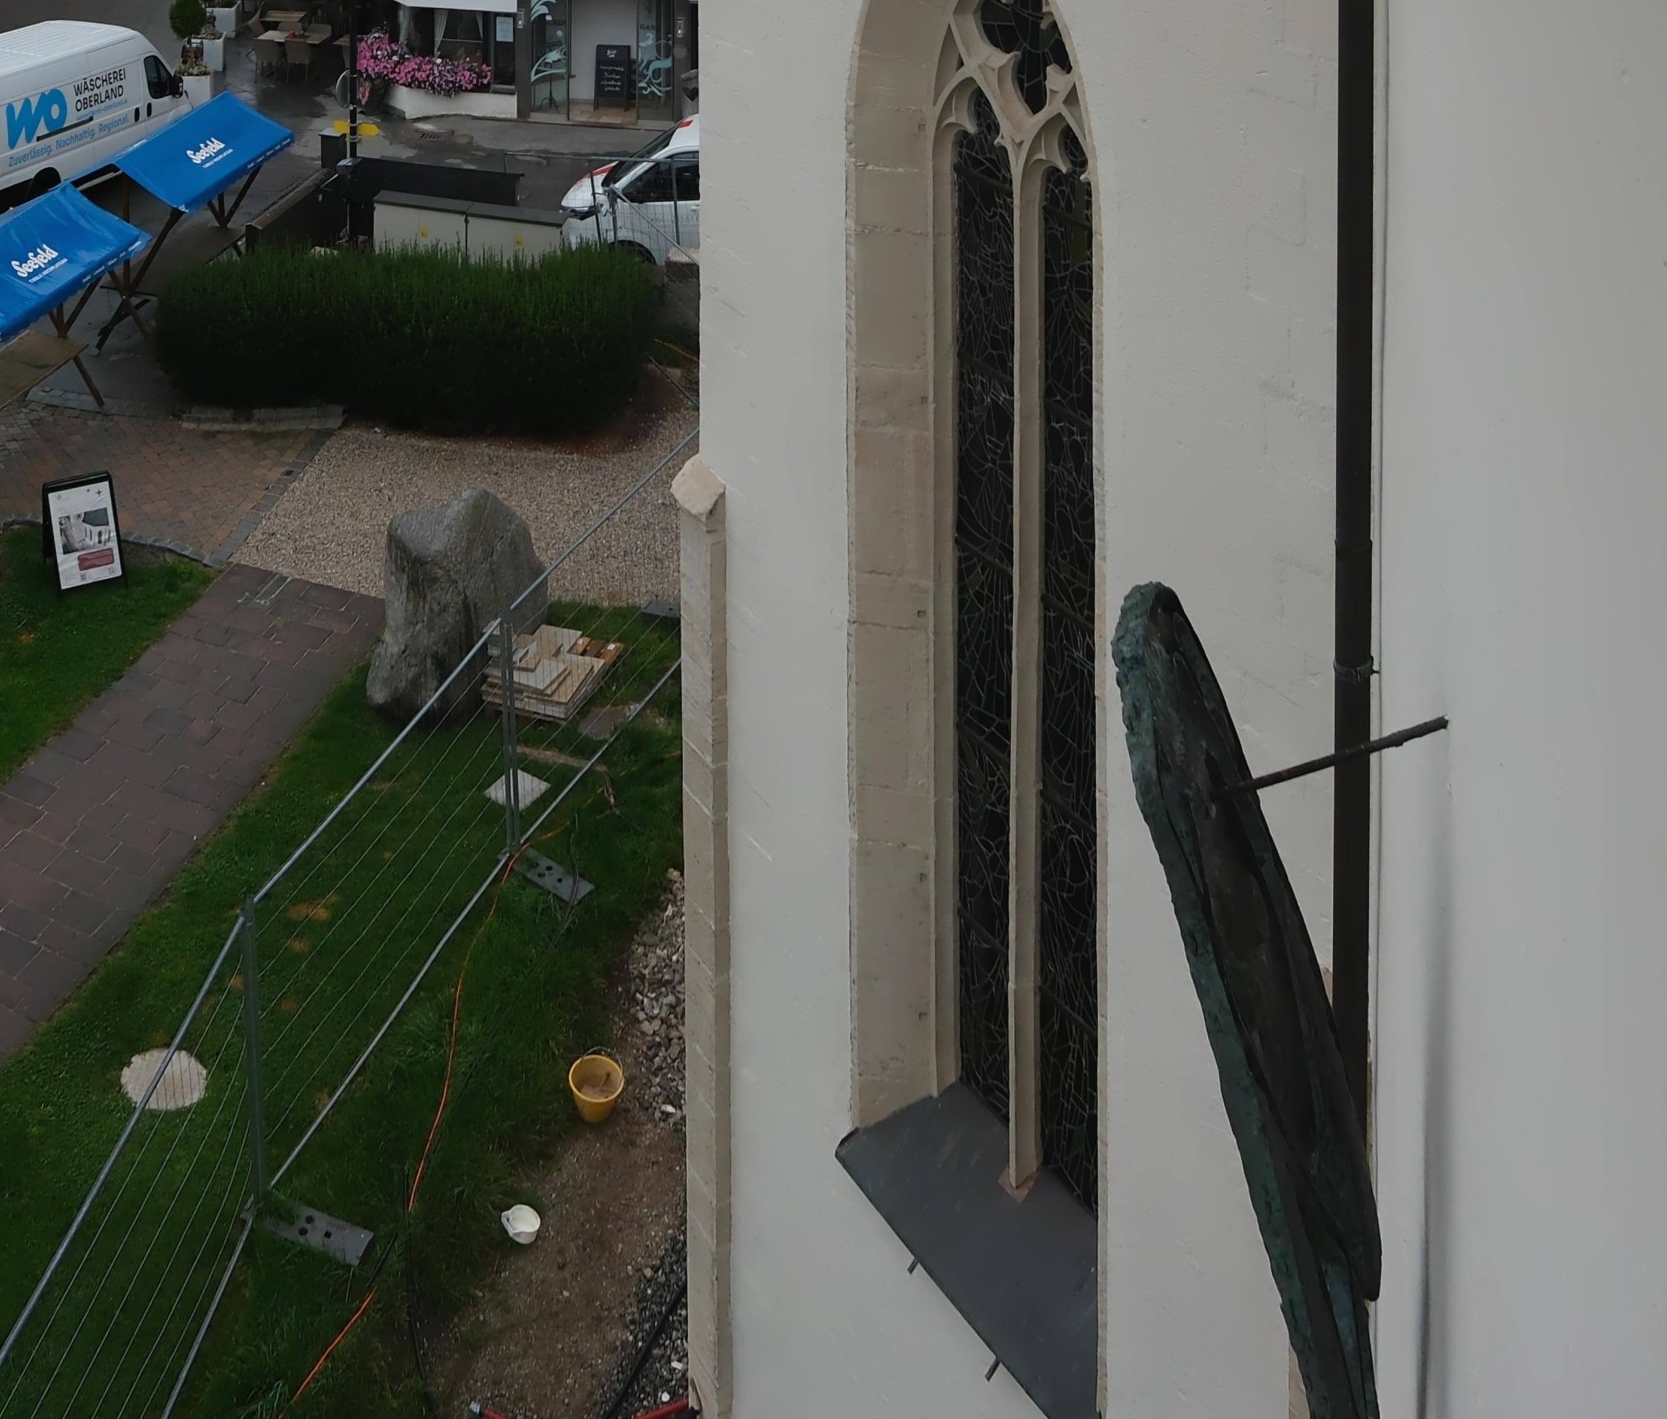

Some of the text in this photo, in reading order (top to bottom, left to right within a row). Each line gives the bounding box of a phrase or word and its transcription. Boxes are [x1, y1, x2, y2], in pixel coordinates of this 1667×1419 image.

[73, 68, 127, 97] WÄSCHEREI
[75, 85, 125, 113] OBERLAND
[8, 114, 129, 167] Zuverlässig. Nachhaltig. Regional.
[186, 137, 224, 164] Seefeld
[11, 243, 59, 278] Seefeld
